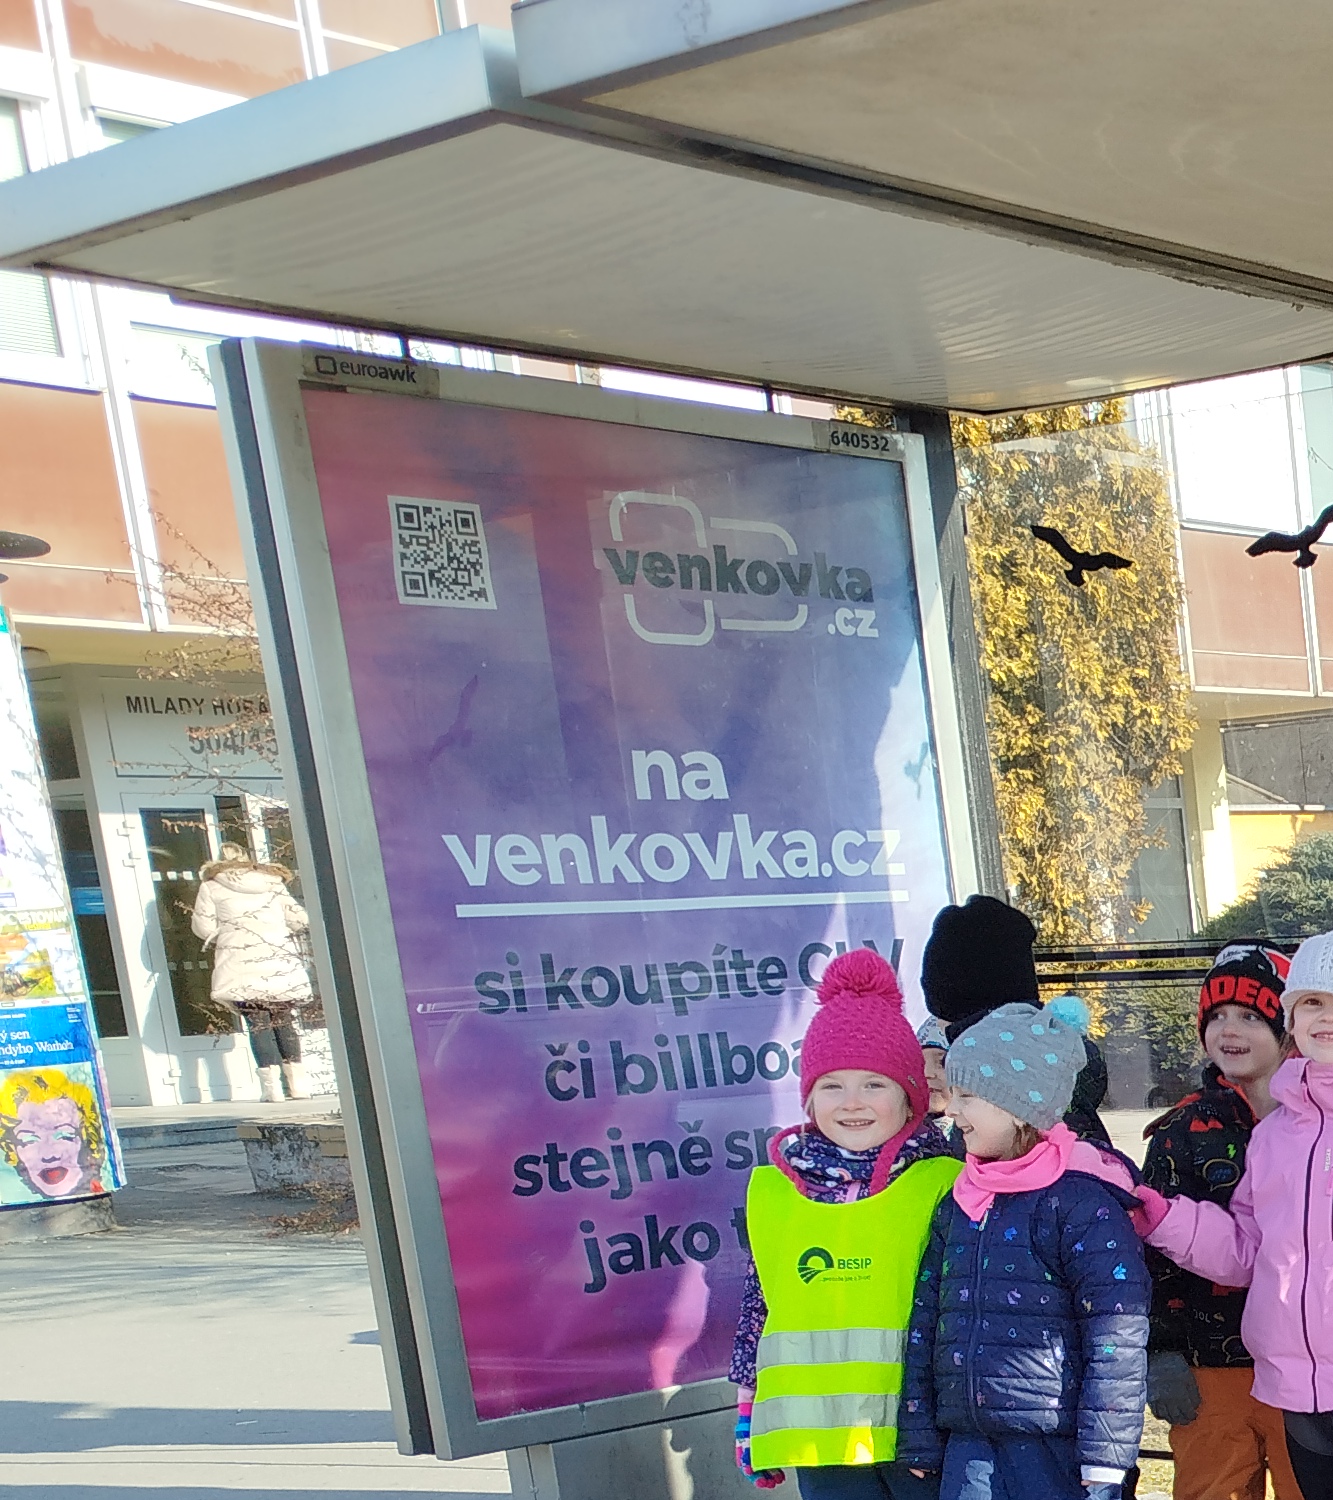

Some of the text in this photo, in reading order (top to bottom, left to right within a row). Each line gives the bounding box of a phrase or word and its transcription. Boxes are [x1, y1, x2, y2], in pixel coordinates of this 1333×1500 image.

[340, 360, 417, 383] euroawk
[831, 430, 890, 452] 640532
[602, 544, 875, 603] venkovka
[126, 696, 205, 716] MILADY
[631, 748, 729, 802] na
[442, 814, 907, 887] venkovka.cz
[474, 953, 528, 1015] si
[540, 944, 788, 1017] koupíte
[10, 1031, 31, 1041] sen
[544, 1041, 596, 1102] či
[512, 1120, 713, 1200] stejně
[579, 1214, 721, 1294] jako
[837, 1257, 872, 1270] BESIP
